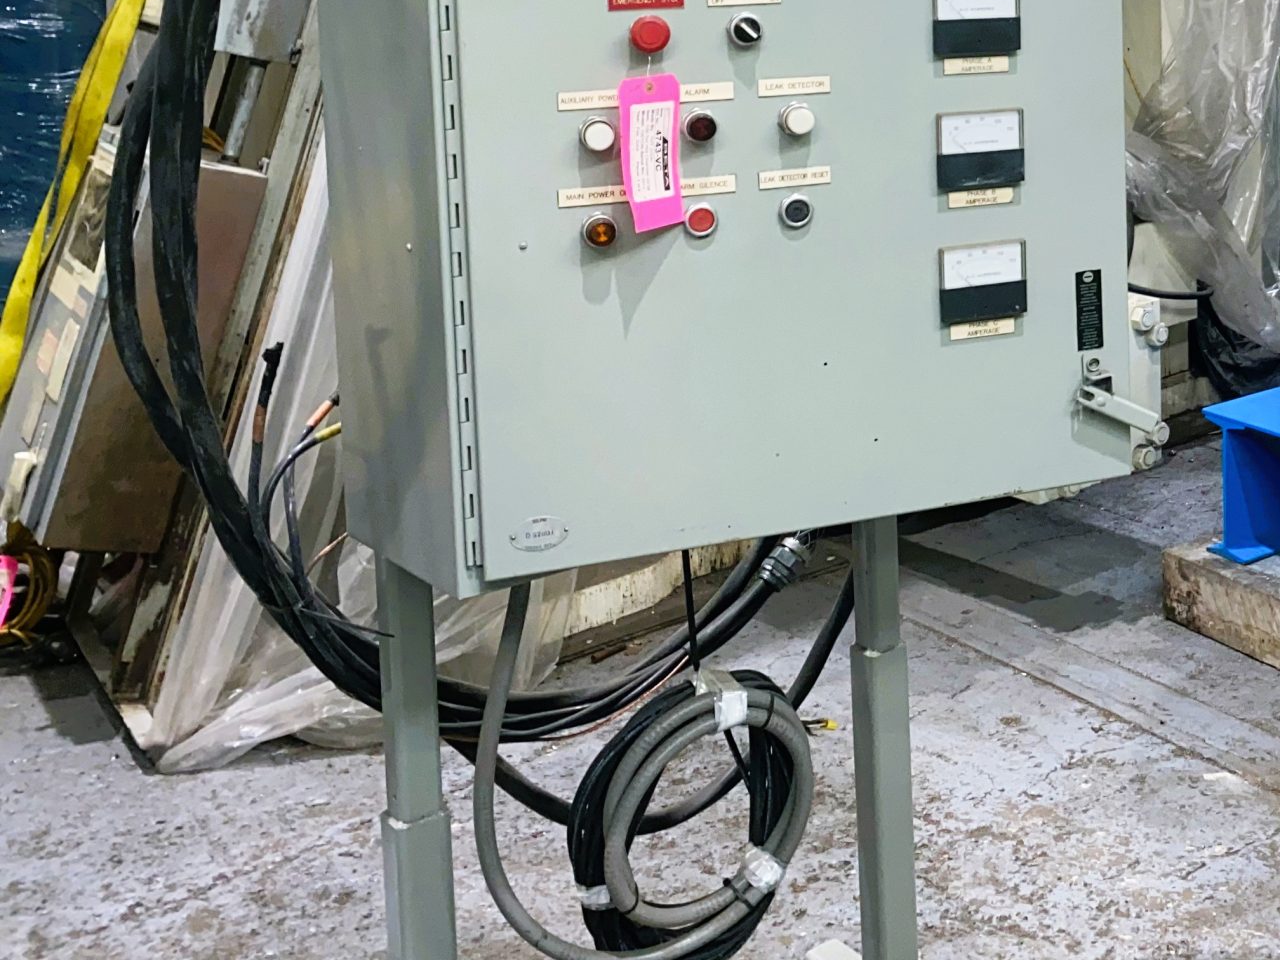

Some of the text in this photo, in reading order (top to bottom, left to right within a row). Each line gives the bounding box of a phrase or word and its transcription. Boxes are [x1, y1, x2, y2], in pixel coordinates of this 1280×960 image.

[788, 81, 825, 89] DETECTOR
[684, 88, 710, 96] ALARM
[560, 96, 593, 104] AUXILIARY
[566, 193, 584, 201] MAIN
[588, 190, 615, 198] POWER
